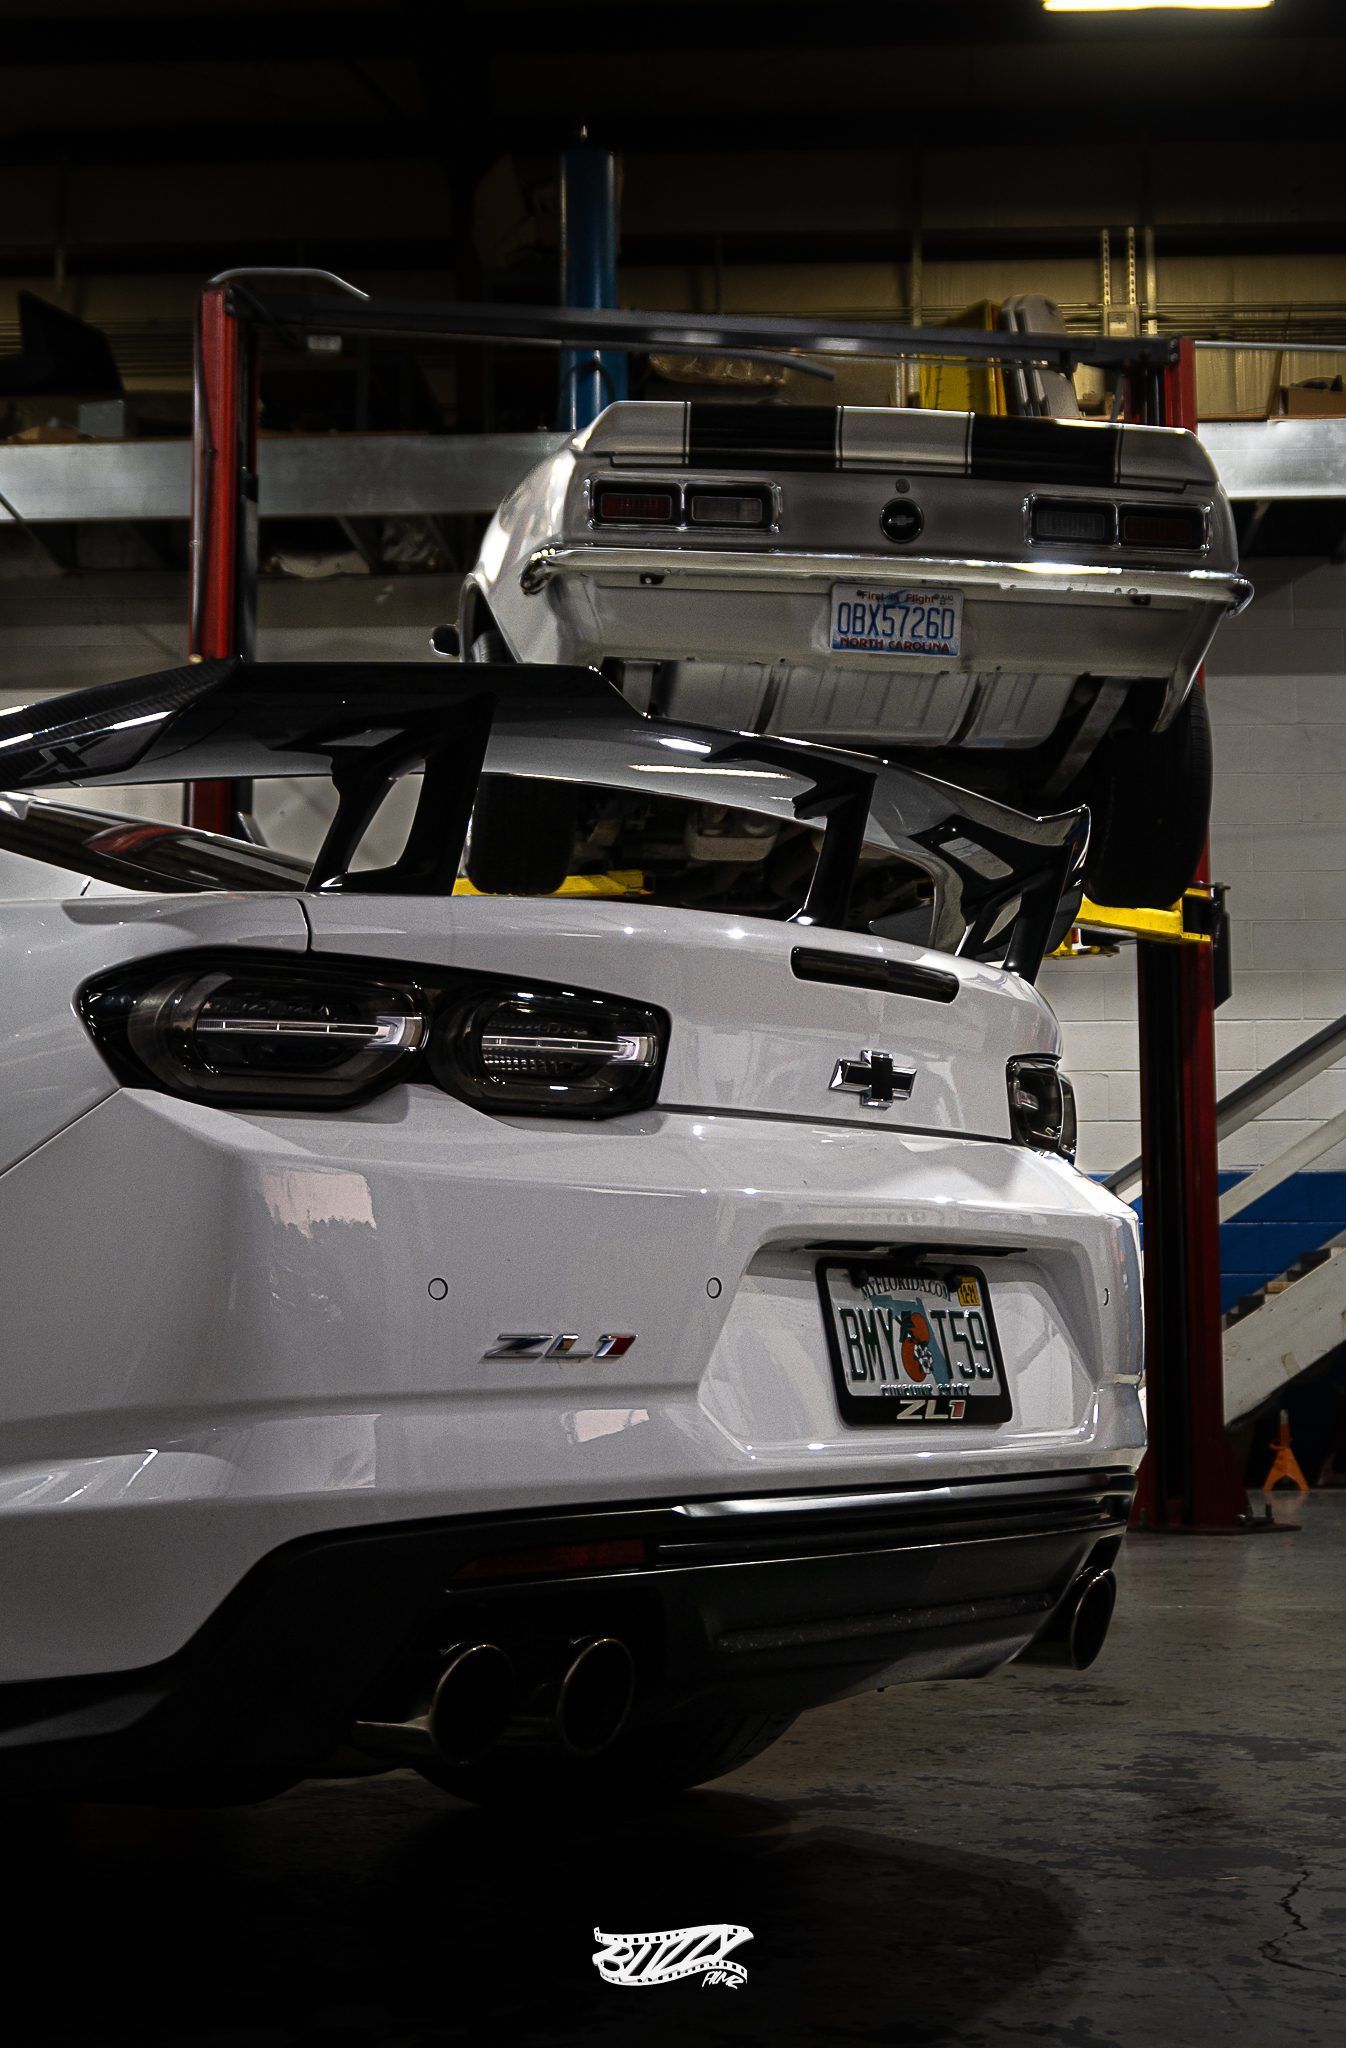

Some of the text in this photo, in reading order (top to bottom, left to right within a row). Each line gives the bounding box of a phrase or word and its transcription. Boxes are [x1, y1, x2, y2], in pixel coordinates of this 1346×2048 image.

[840, 636, 950, 653] NORTH CAROLINA
[930, 1309, 994, 1379] T59
[896, 1399, 966, 1420] ZL1
